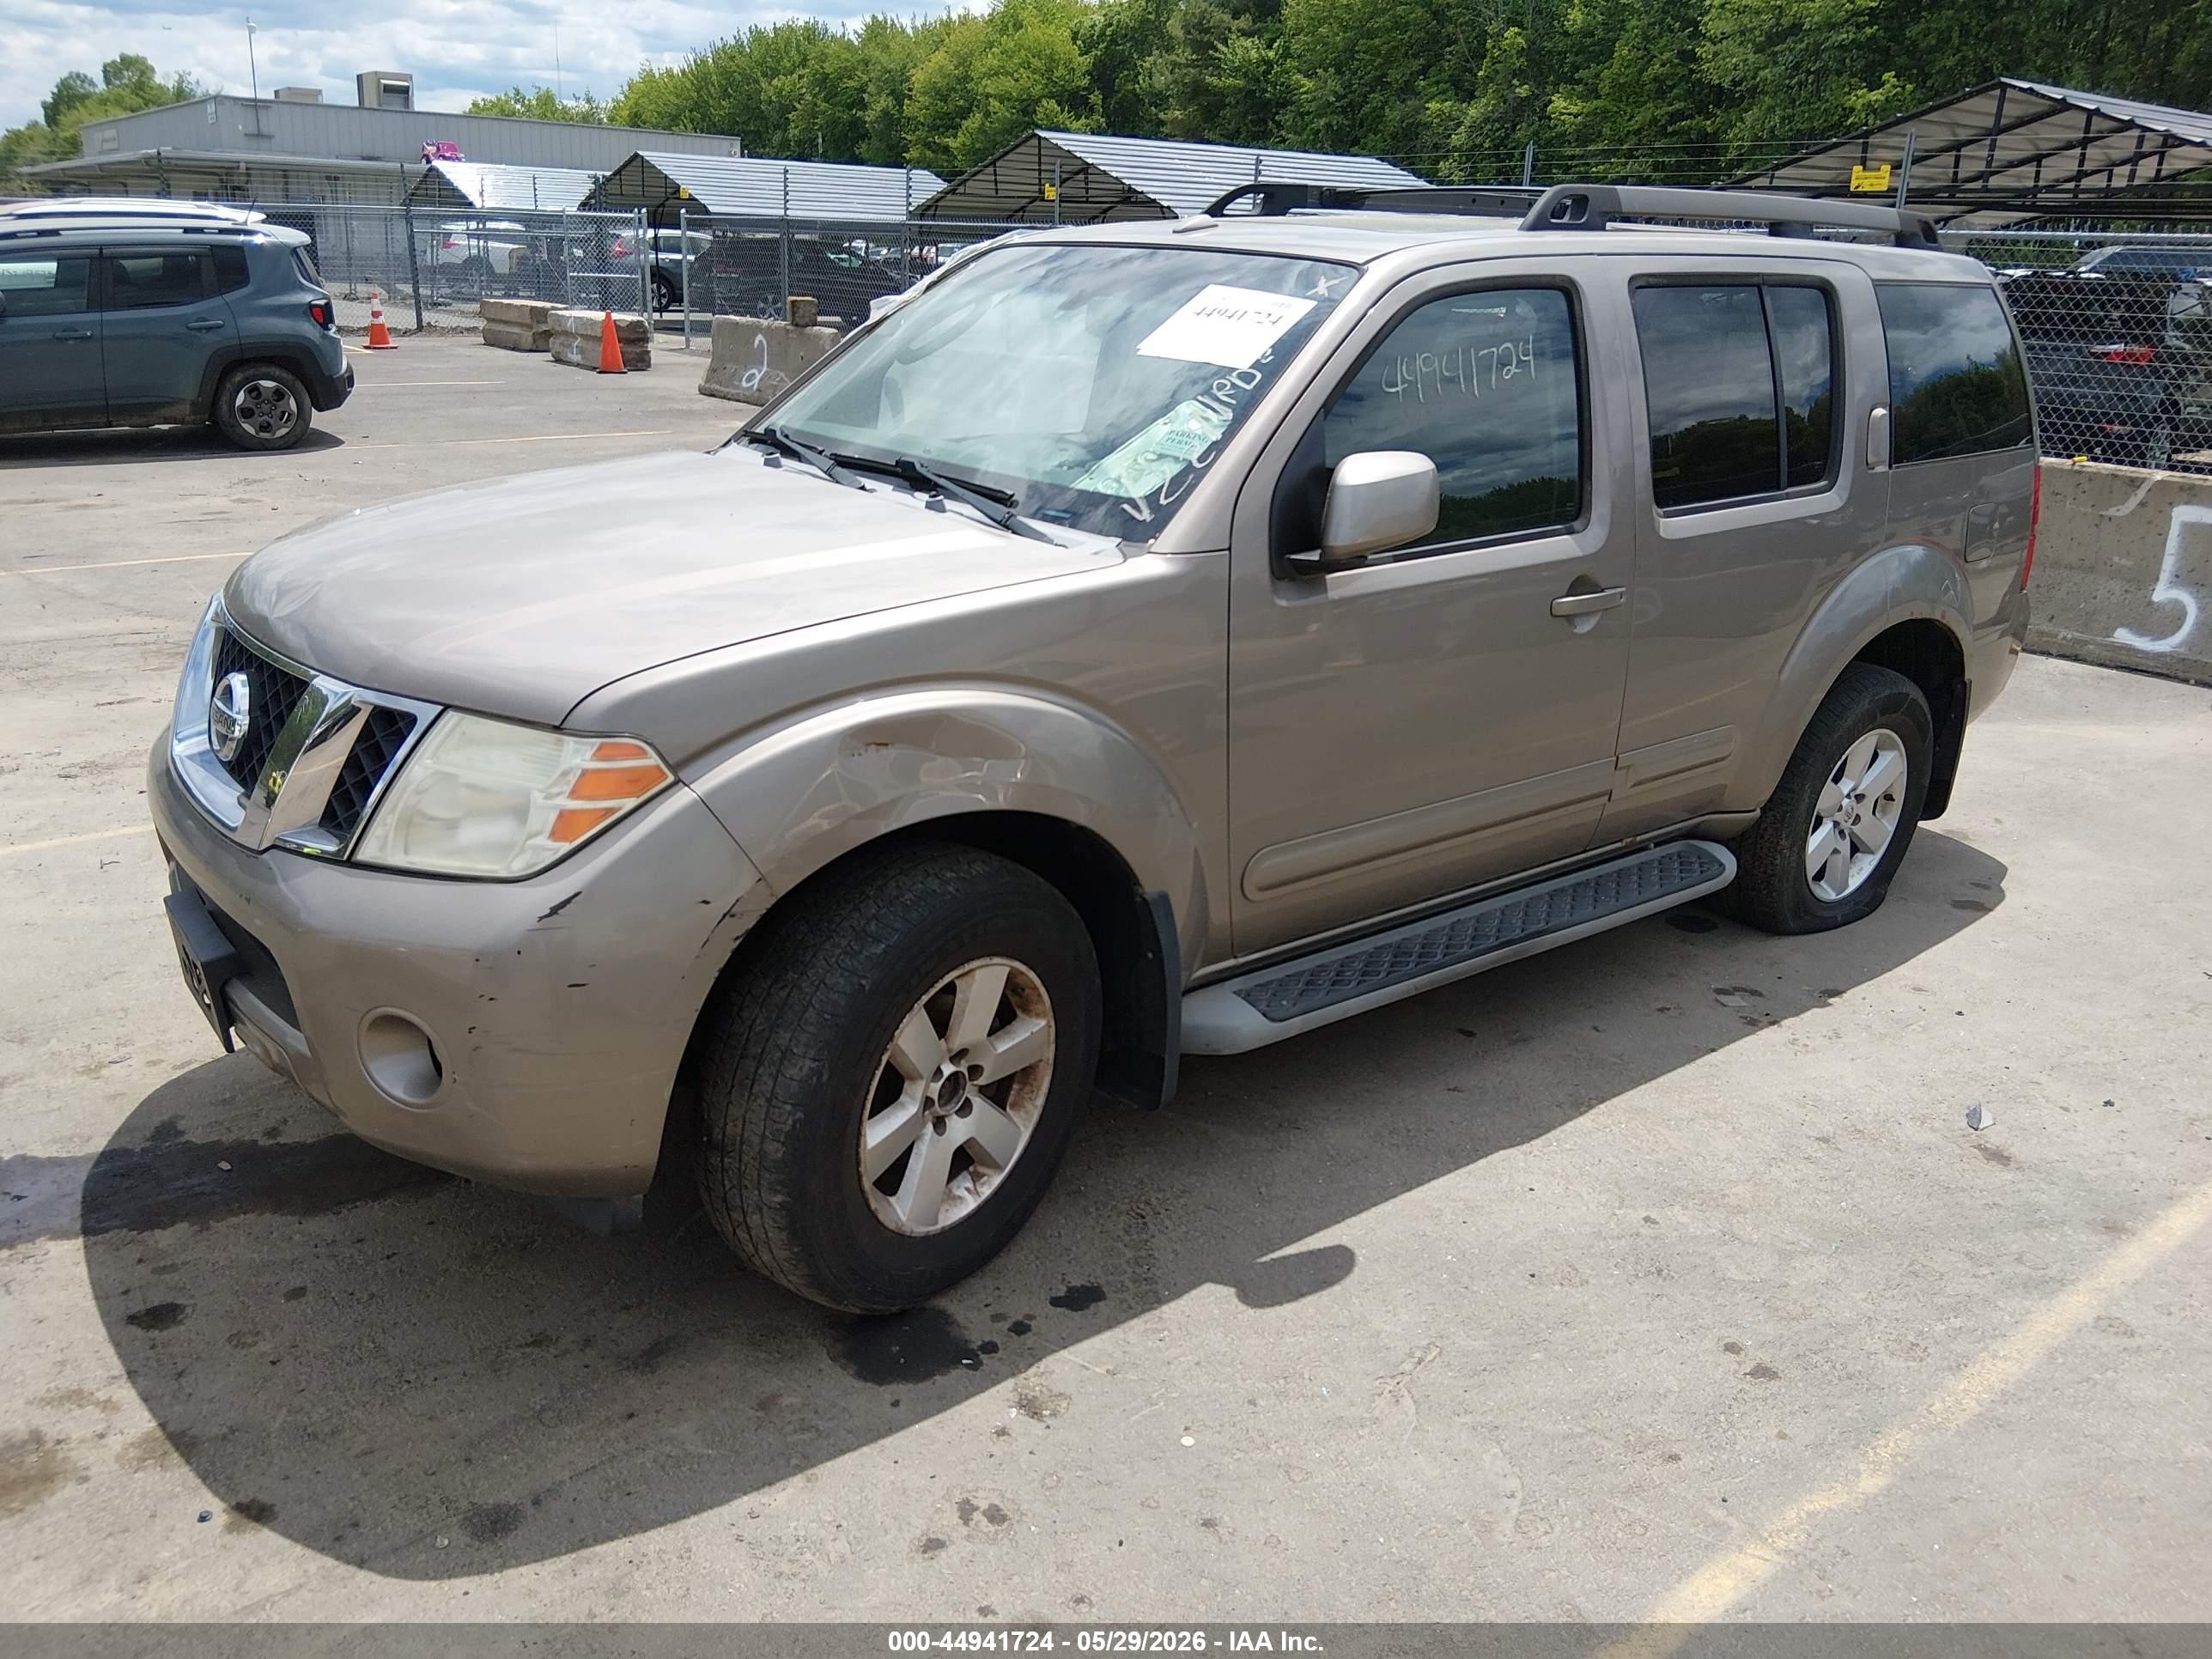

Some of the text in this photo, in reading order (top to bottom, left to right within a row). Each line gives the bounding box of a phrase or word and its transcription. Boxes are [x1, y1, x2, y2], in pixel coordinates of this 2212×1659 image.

[741, 333, 768, 392] 2
[1382, 334, 1536, 404] 44941724
[2113, 505, 2212, 653] 5
